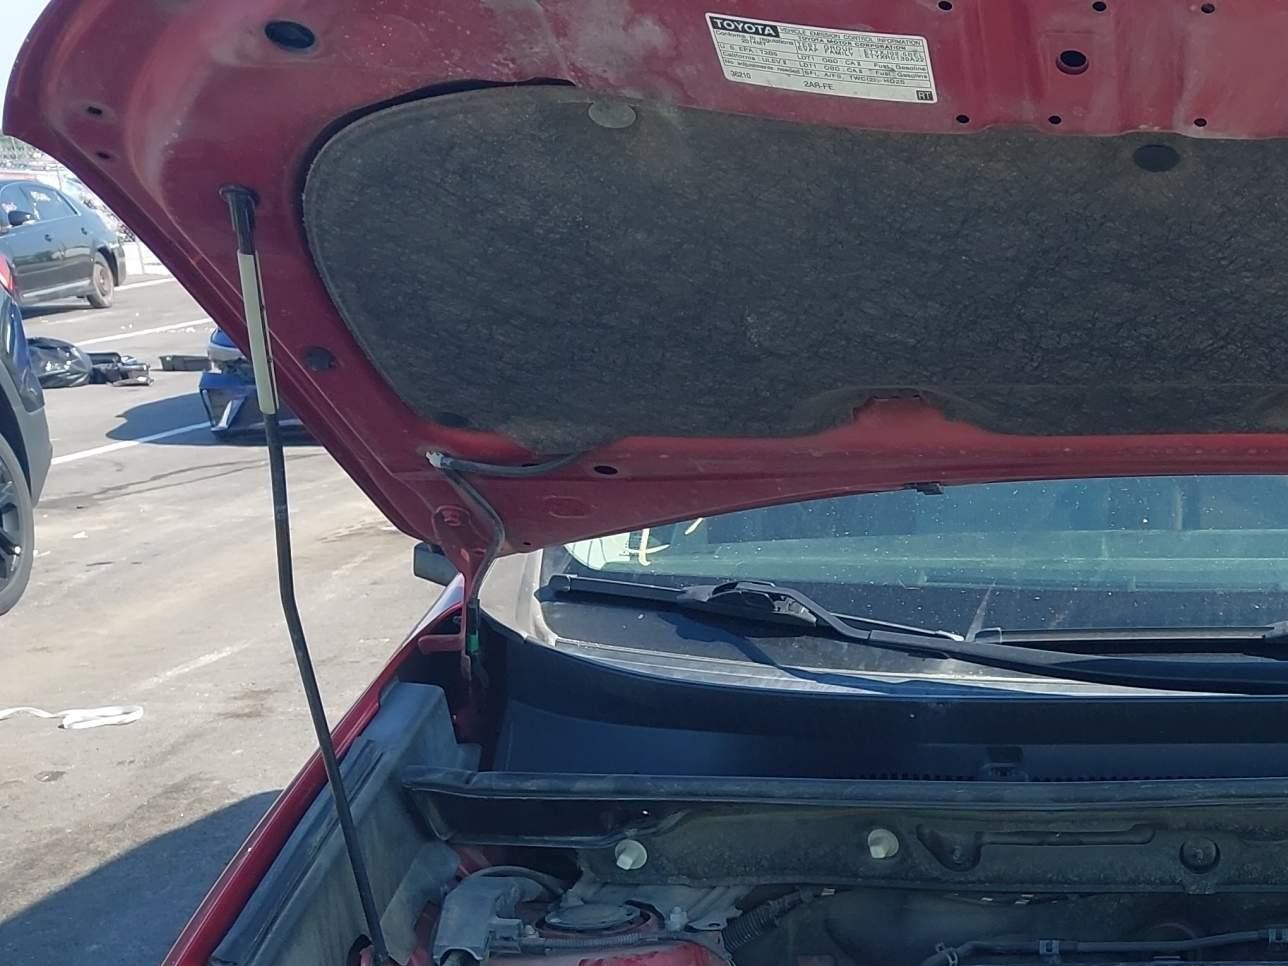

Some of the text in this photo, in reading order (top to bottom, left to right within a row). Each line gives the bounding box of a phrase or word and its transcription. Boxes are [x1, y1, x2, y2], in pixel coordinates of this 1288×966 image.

[713, 19, 777, 36] TOYOTA
[854, 42, 906, 50] CORPORATION
[877, 37, 921, 46] INFORMATION
[803, 81, 833, 90] 2AR-FE
[918, 91, 931, 100] RT
